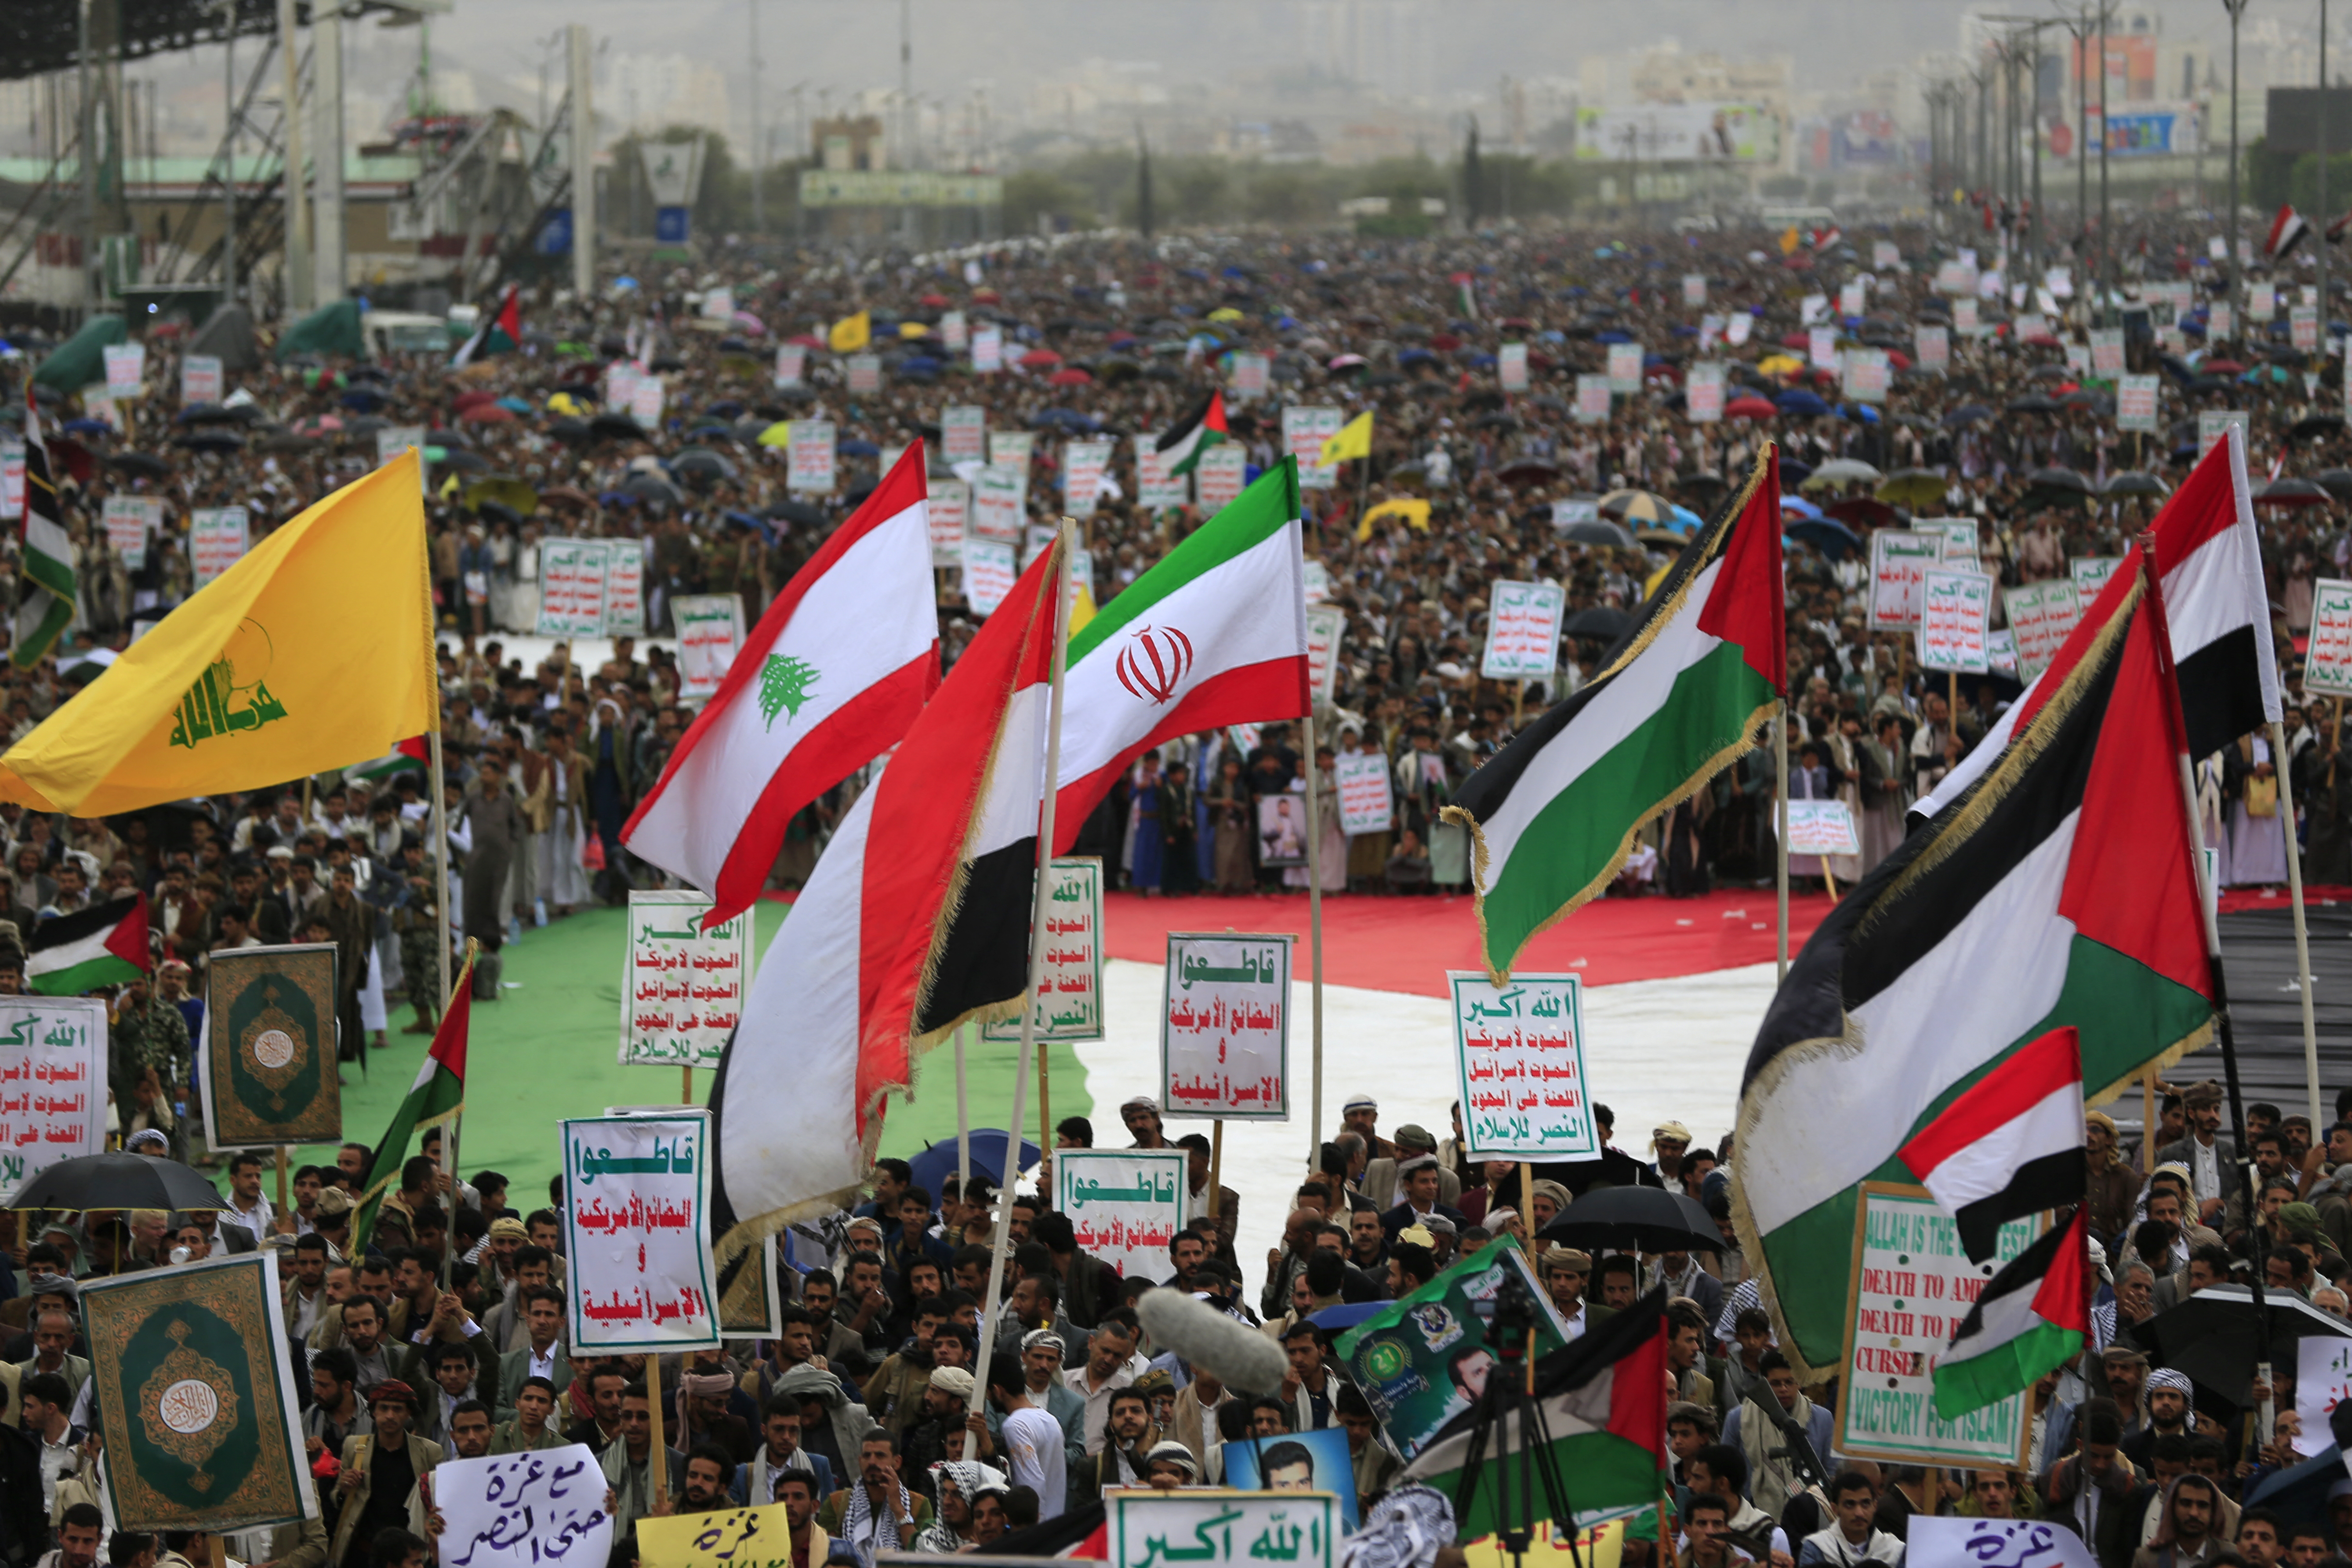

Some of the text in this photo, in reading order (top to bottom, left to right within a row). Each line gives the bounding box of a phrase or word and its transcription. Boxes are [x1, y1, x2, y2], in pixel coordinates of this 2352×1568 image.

[1046, 914, 1091, 937] الموت
[692, 952, 739, 973] الموت
[1046, 945, 1091, 968] الموت
[1178, 946, 1274, 990] قاطعوا
[692, 982, 738, 1003] الموت
[1463, 984, 1571, 1026] الله أكبر
[1218, 1037, 1226, 1064] و
[1526, 1029, 1573, 1052] الموت
[35, 1061, 86, 1085] الموت
[1529, 1061, 1577, 1082] الموت
[34, 1092, 85, 1116] الموت
[1470, 1088, 1580, 1111] اللعنة على اليهود
[1536, 1113, 1585, 1145] النصر
[573, 1135, 694, 1186] قاطعوا
[1067, 1170, 1174, 1210] قاطعوا
[1865, 1210, 1909, 1252] ALLAH
[1911, 1213, 1926, 1254] IS
[1929, 1215, 1956, 1257] THE
[637, 1242, 646, 1273] و
[1862, 1268, 1917, 1298] DEATH
[1922, 1274, 1945, 1300] TO
[1859, 1308, 1915, 1337] DEATH
[1921, 1314, 1944, 1339] TO
[1855, 1387, 1924, 1437] VICTORY
[485, 1453, 586, 1509] مع غزة
[691, 1510, 760, 1560] غزة
[1249, 1510, 1319, 1561] الله
